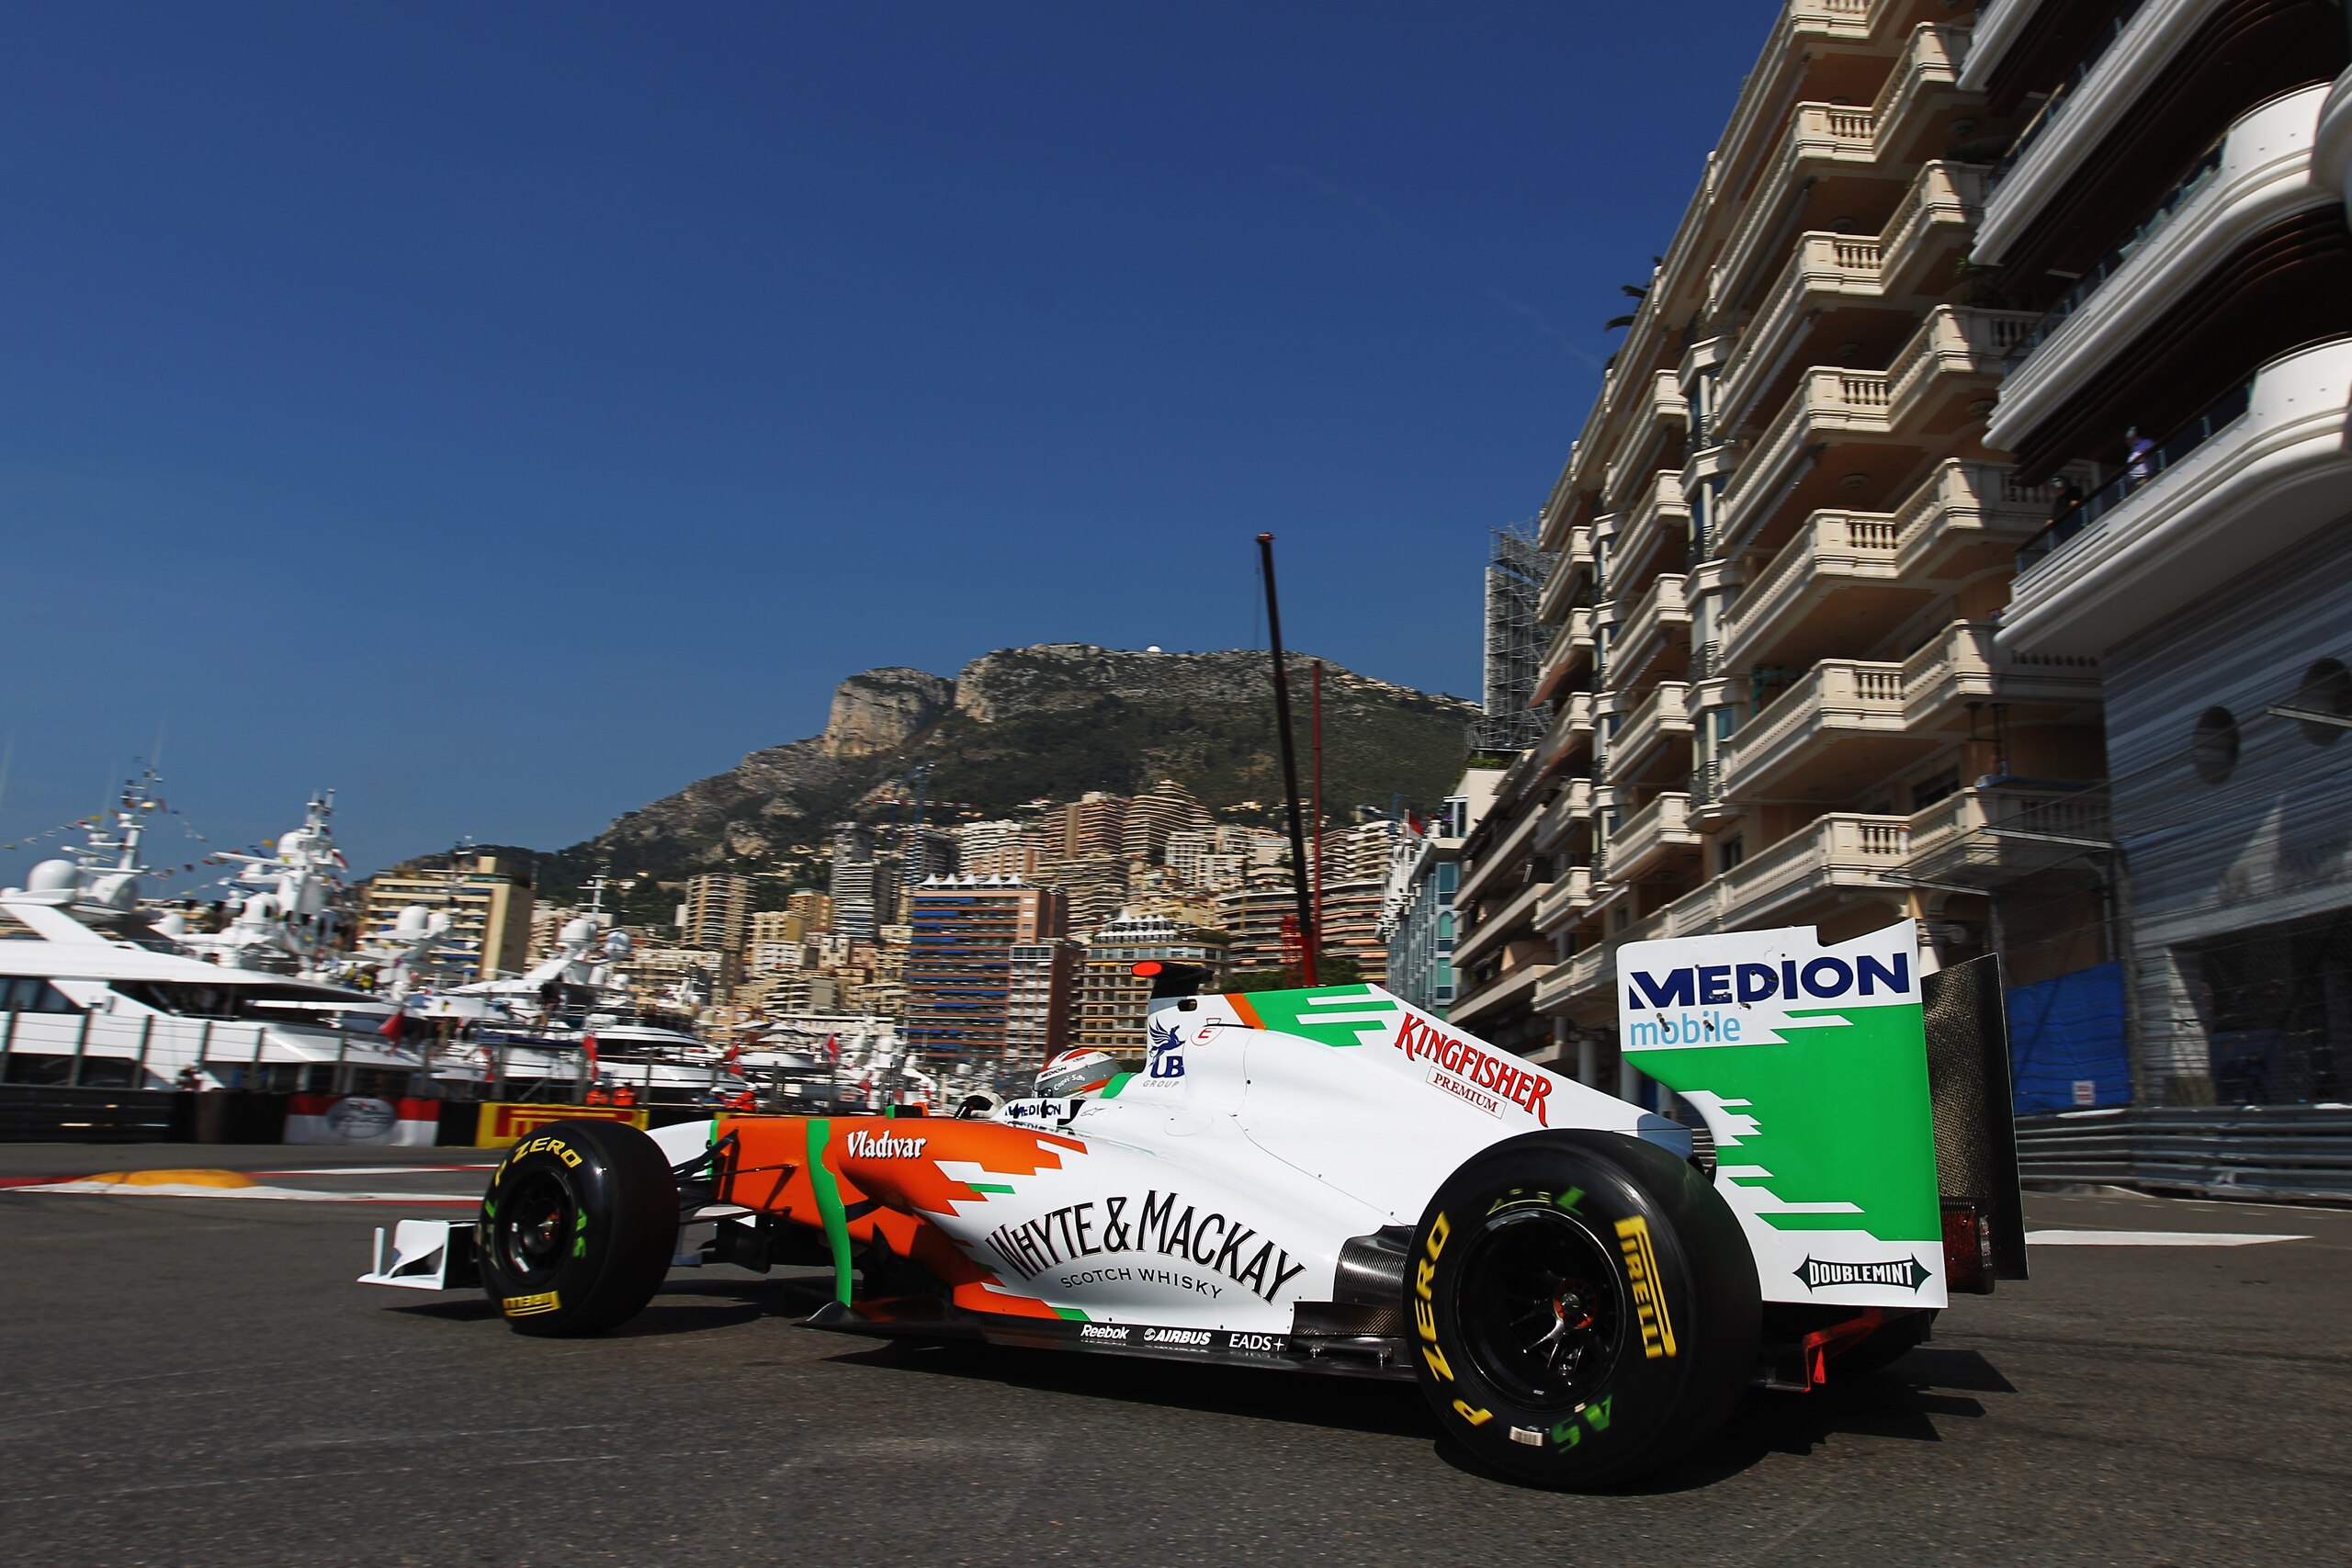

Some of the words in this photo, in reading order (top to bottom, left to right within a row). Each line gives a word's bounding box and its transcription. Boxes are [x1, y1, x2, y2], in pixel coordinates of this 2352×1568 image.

[1629, 953, 1910, 1010] MEDION
[1630, 1011, 1741, 1045] mobile
[1150, 1055, 1185, 1078] UB
[1395, 1012, 1553, 1128] KINGFISHER
[1143, 1079, 1180, 1089] GROUP
[1433, 1073, 1498, 1113] PREMIUM
[513, 1136, 583, 1168] ZERO
[847, 1130, 927, 1158] Vladivar
[985, 1201, 1102, 1281] WHYTE
[1102, 1196, 1132, 1252] &
[1136, 1190, 1306, 1305] MACKAY
[1060, 1268, 1132, 1289] SCOTCH
[1139, 1269, 1223, 1300] WHISKY
[1613, 1214, 1677, 1359] PIRELLI
[1809, 1261, 1914, 1286] DOUBLEMINT
[1415, 1211, 1454, 1382] ZERO
[1080, 1324, 1130, 1340] Reebok
[1153, 1329, 1211, 1346] AIRBUS
